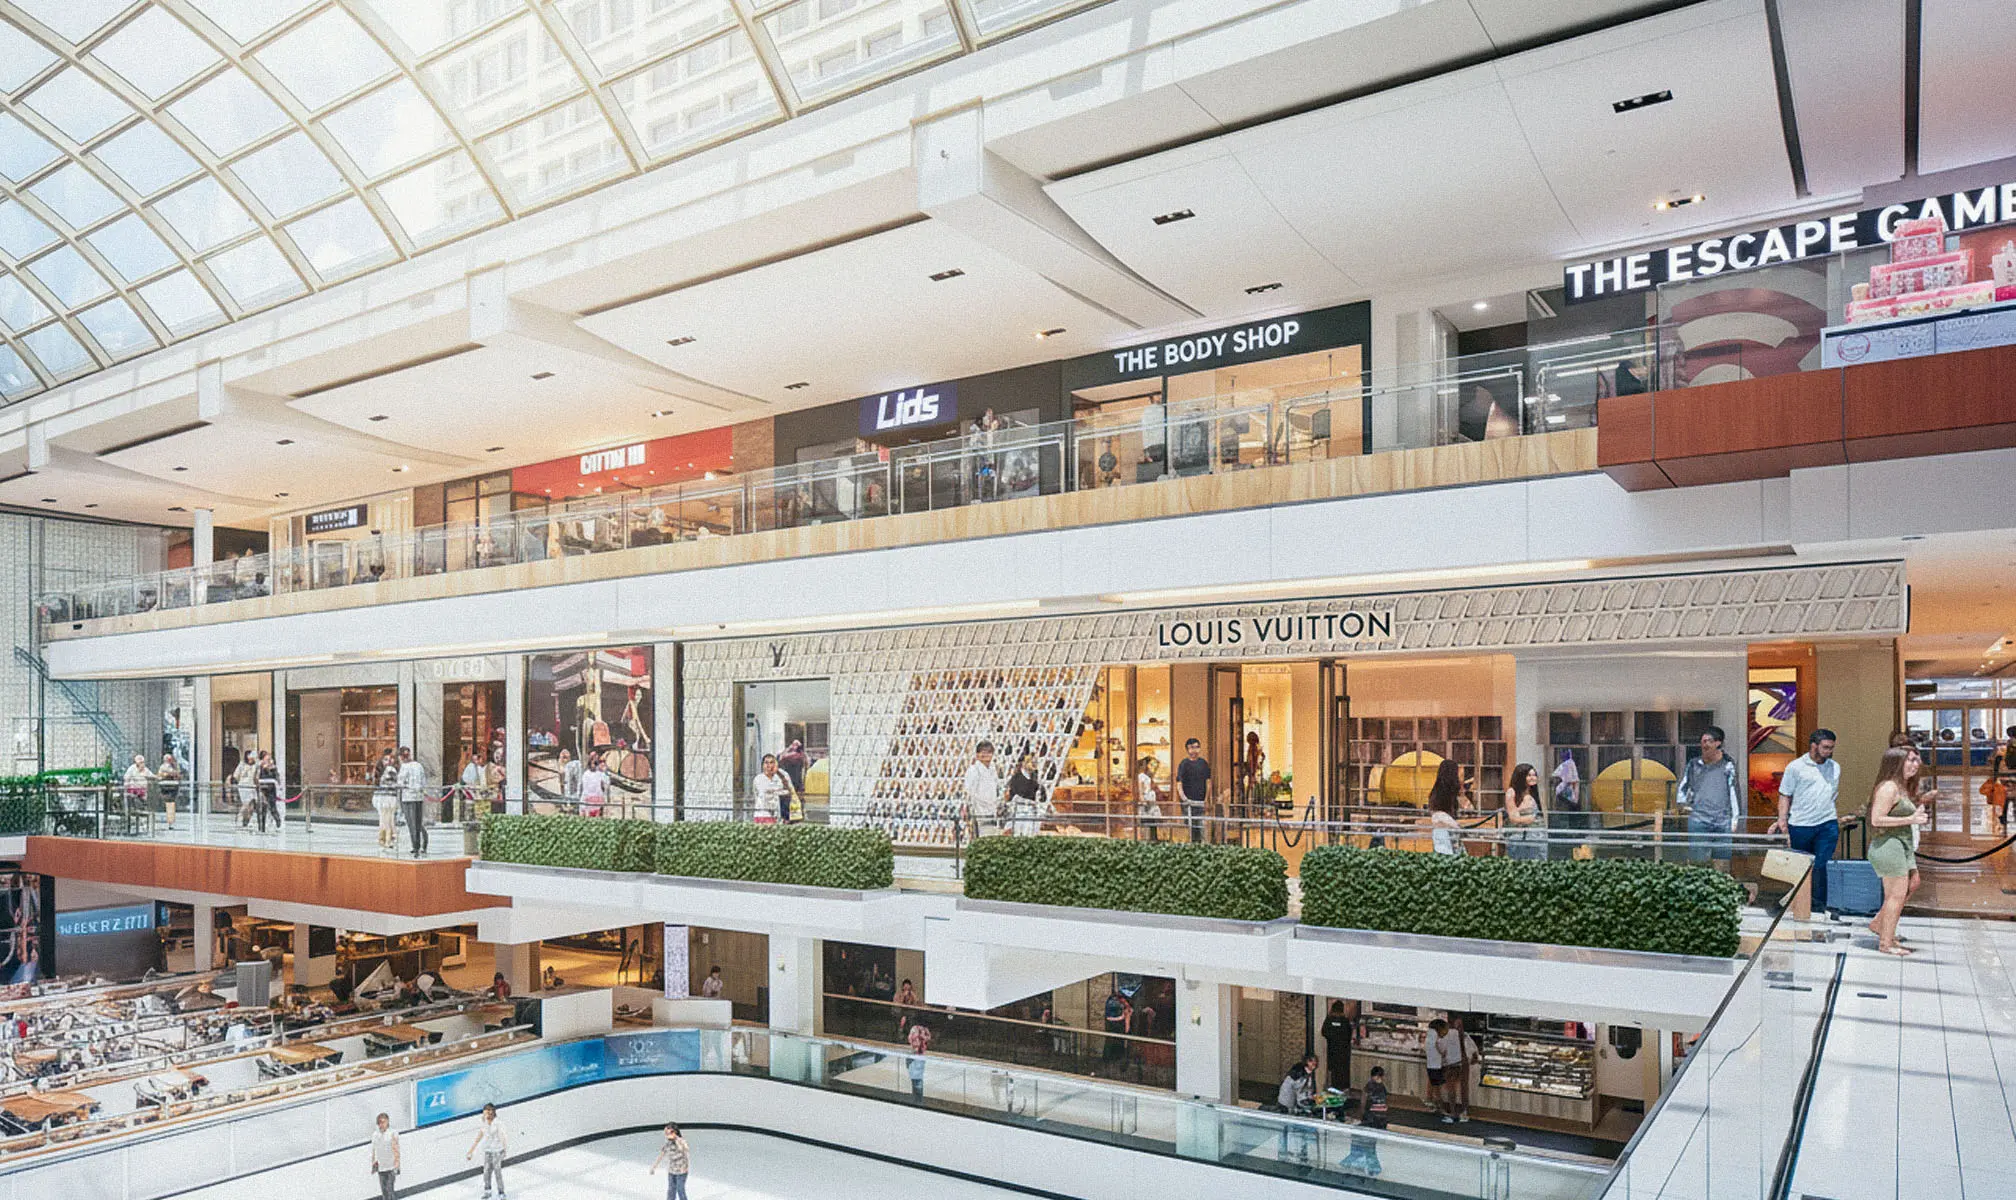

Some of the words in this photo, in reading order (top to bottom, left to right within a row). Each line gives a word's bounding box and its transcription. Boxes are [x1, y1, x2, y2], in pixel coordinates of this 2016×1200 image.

[1566, 253, 1651, 299] THE
[1668, 212, 1858, 282] ESCAPE
[1114, 346, 1158, 374] THE
[1165, 332, 1228, 366] BODY
[1233, 320, 1300, 353] SHOP
[876, 388, 940, 430] Lids
[1159, 619, 1242, 647] LOUIS
[1252, 611, 1391, 643] VUITTON
